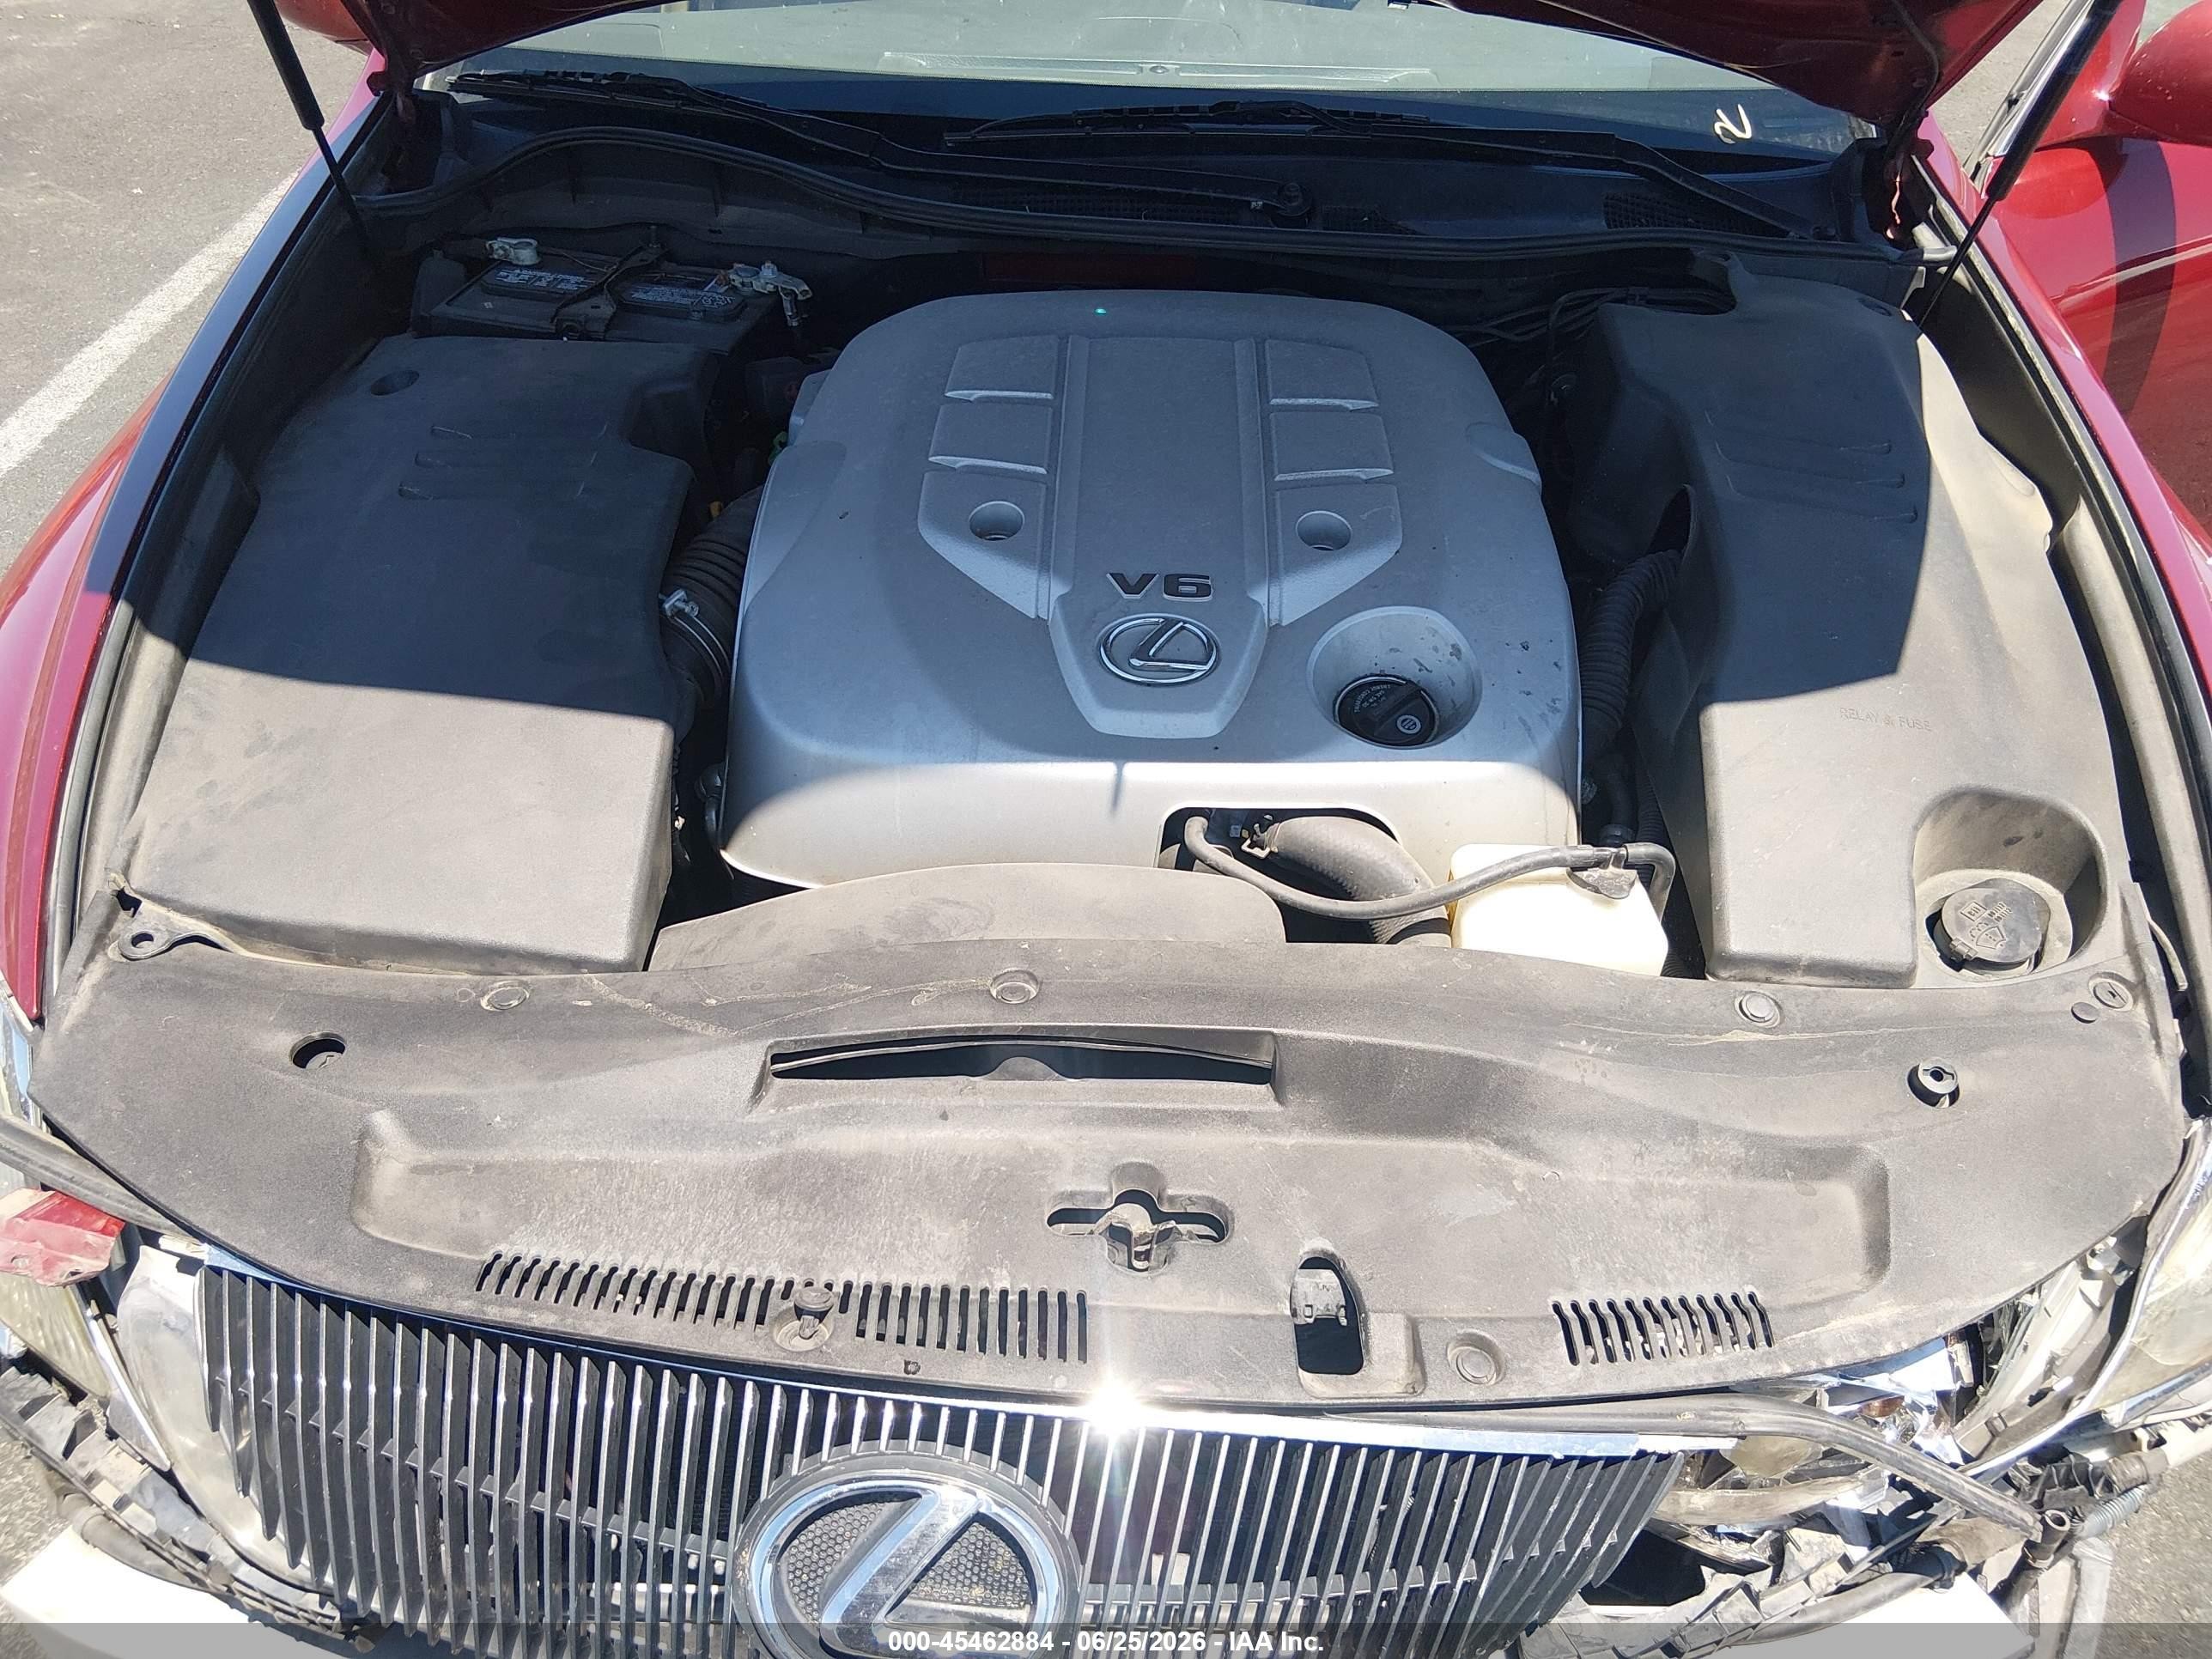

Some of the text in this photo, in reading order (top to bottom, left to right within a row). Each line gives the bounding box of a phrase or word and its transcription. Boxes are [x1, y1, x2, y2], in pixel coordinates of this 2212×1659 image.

[1106, 573, 1213, 602] V6
[1839, 707, 1879, 724] RELAY
[1898, 715, 1933, 732] FUSE
